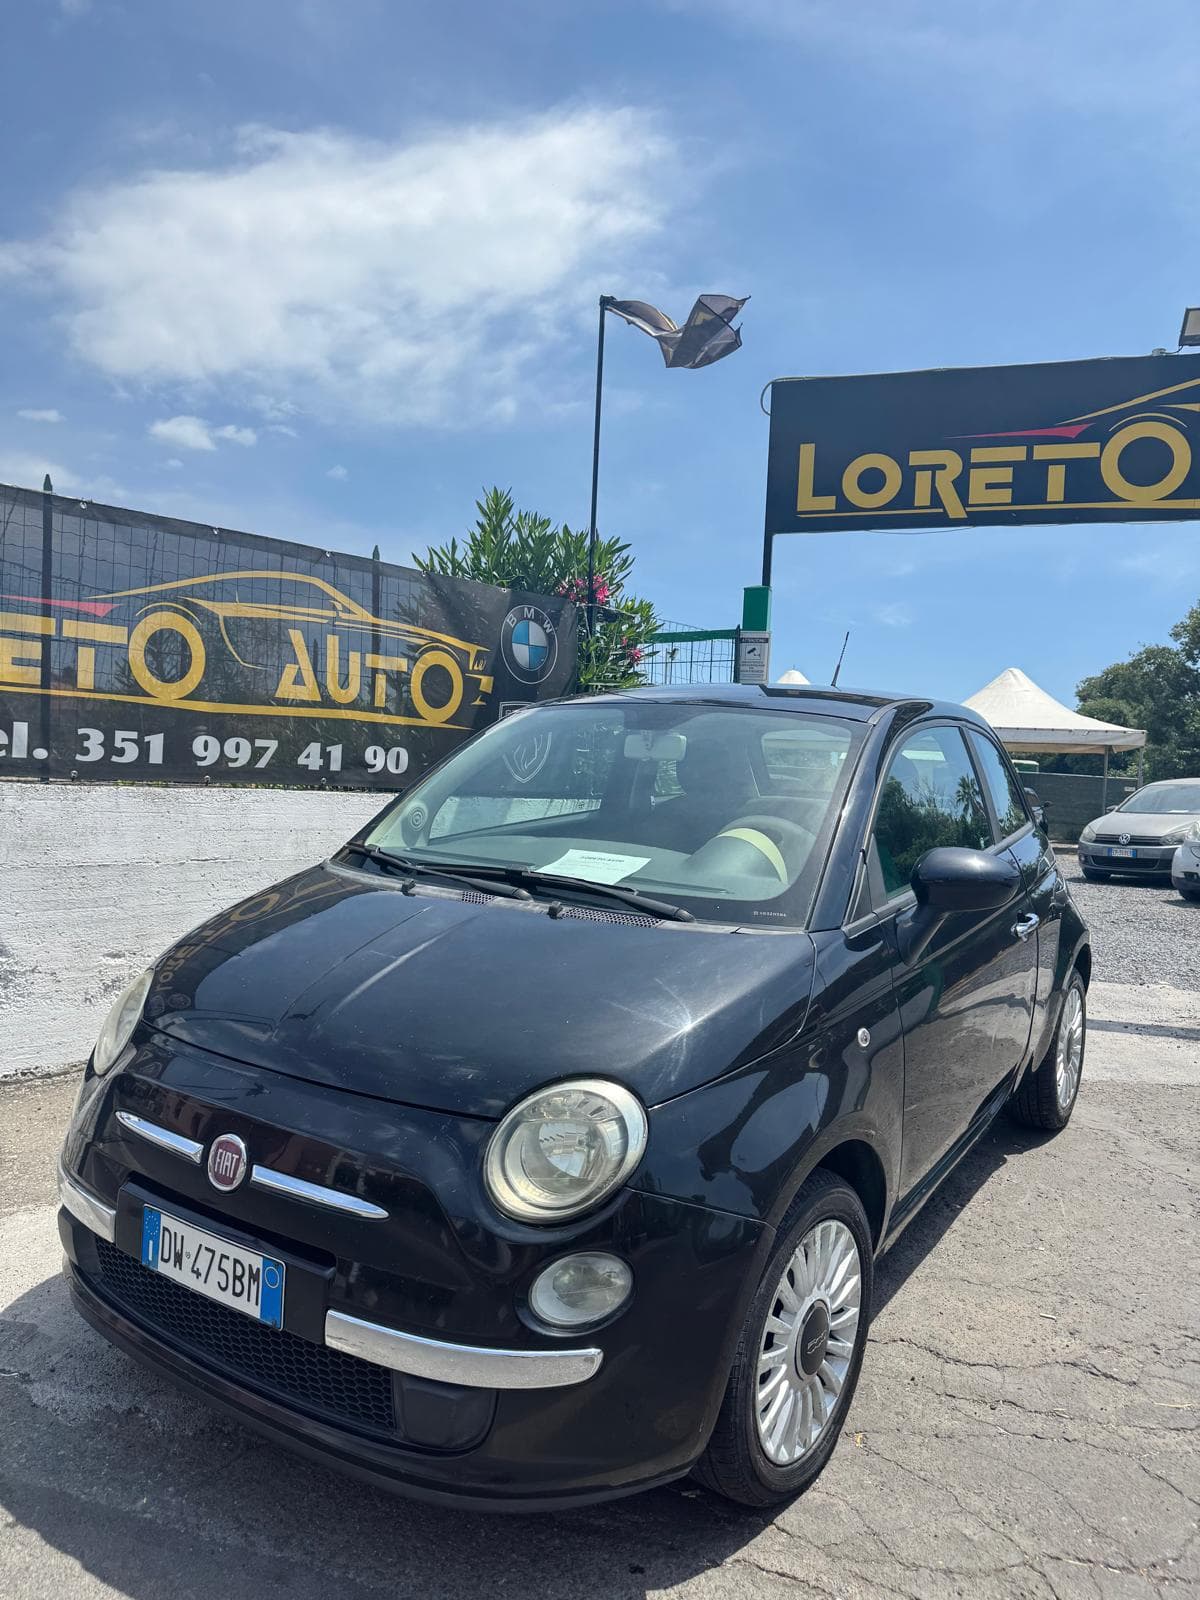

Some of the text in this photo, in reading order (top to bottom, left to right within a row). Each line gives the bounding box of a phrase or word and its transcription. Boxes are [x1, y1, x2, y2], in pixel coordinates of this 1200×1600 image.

[798, 421, 1191, 518] LORETO
[507, 607, 554, 634] BMW
[274, 628, 464, 724] AUTO
[75, 727, 164, 764] 351
[192, 735, 279, 768] 997
[297, 742, 343, 771] 41
[364, 745, 409, 774] 90
[214, 1148, 240, 1179] FIAT
